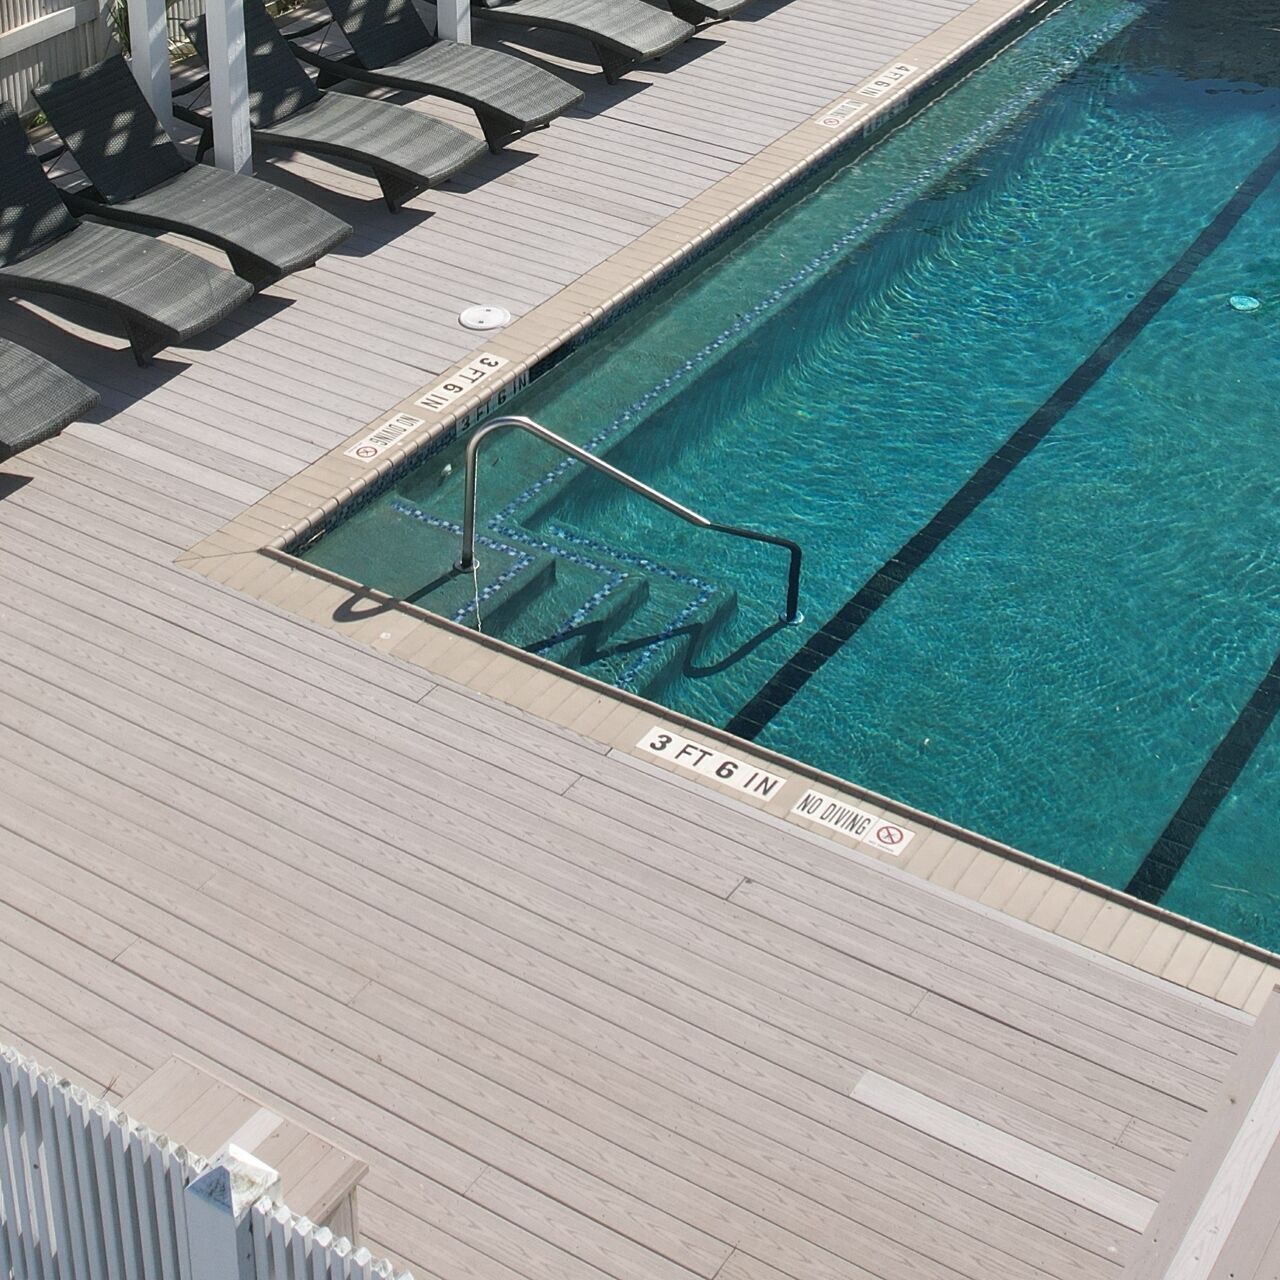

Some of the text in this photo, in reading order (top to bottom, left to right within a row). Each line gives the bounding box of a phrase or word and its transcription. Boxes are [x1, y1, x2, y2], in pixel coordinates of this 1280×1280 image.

[874, 80, 890, 88] 6
[420, 357, 500, 410] 3 FT 6 IN
[460, 374, 528, 432] 3 FT 6 IN
[369, 415, 420, 446] NO DIVING
[650, 734, 778, 796] 3 FT 6 IN
[796, 793, 872, 835] NO DIVING
